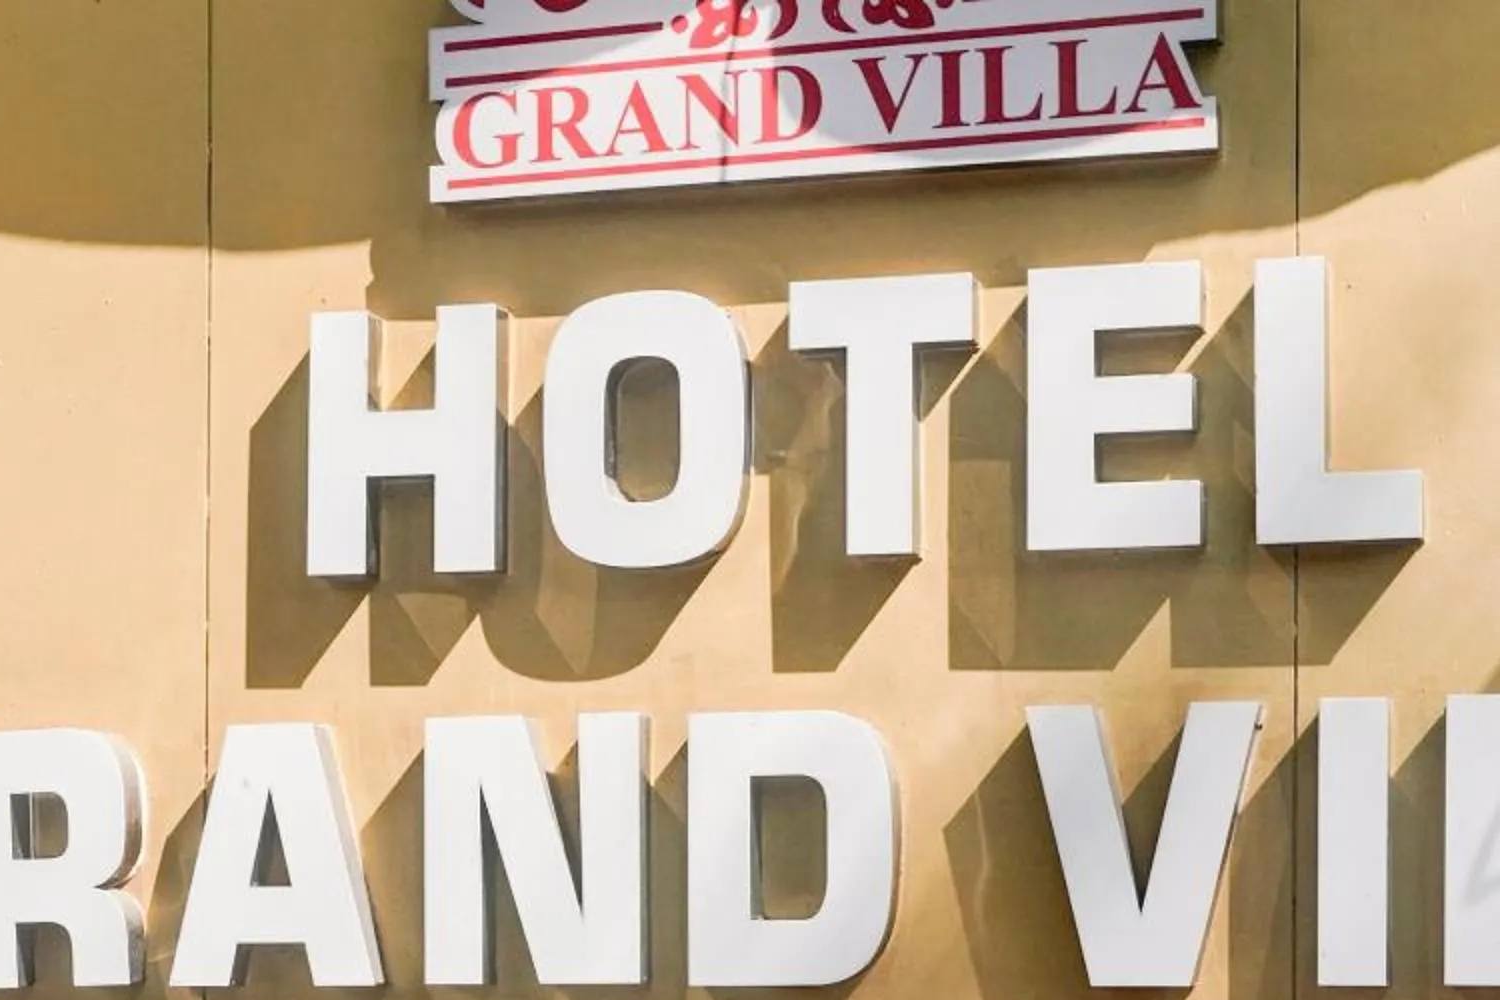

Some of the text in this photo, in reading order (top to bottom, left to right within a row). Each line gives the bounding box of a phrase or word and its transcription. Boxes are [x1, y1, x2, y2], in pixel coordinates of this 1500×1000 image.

[451, 30, 1204, 170] GRAND VILLA
[307, 255, 1425, 578] HOTEL
